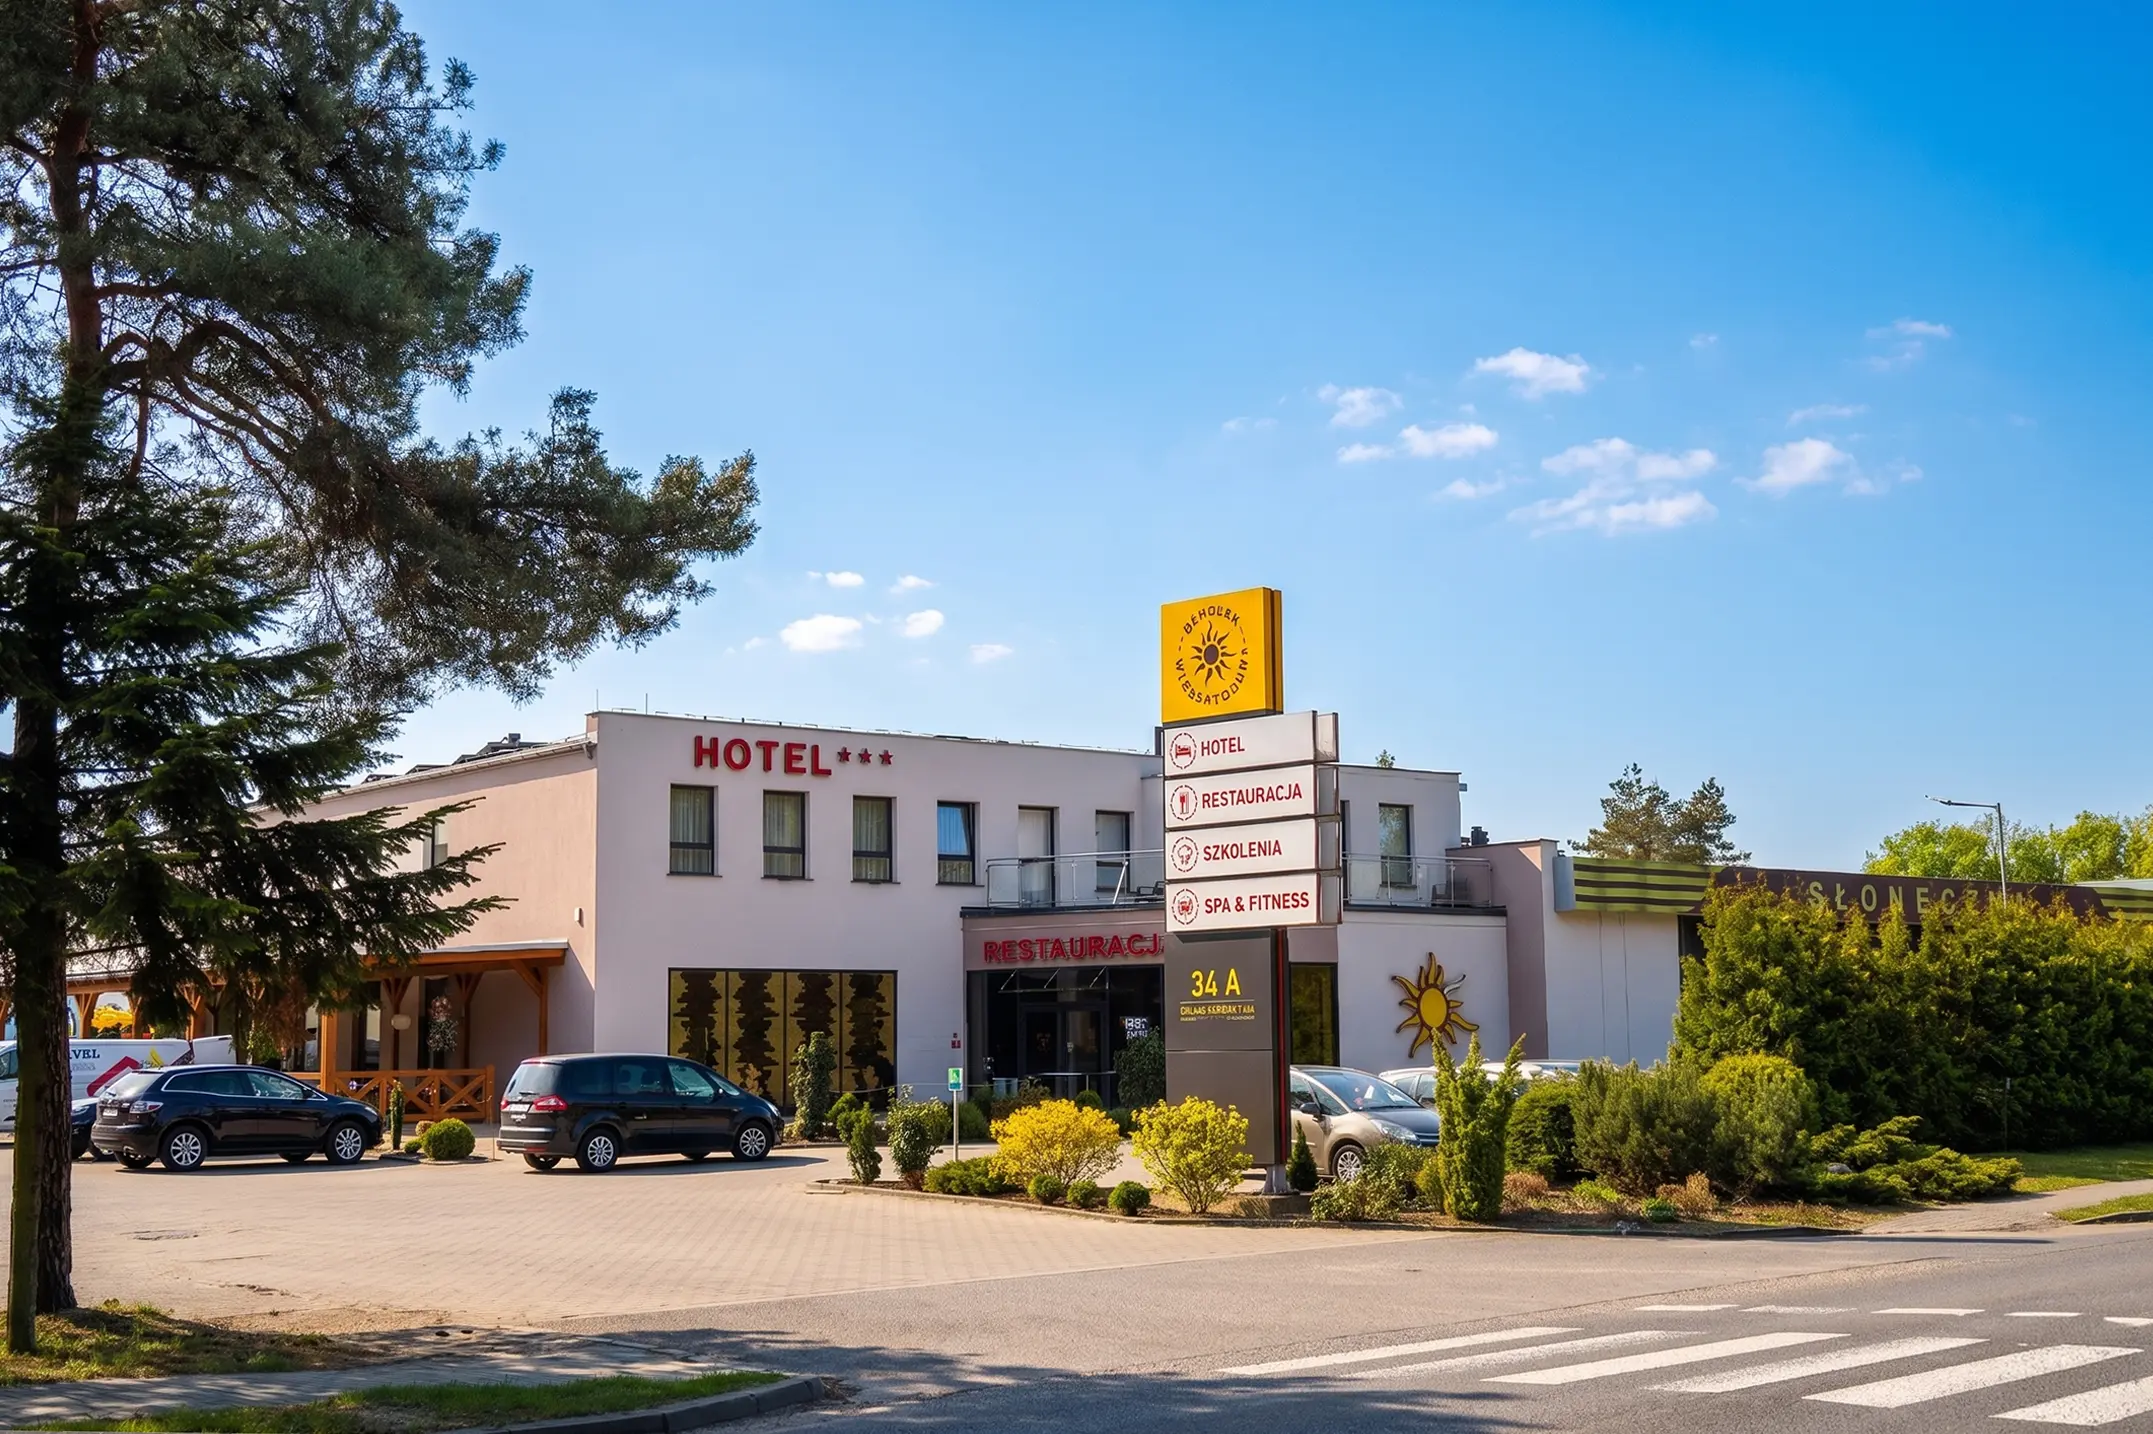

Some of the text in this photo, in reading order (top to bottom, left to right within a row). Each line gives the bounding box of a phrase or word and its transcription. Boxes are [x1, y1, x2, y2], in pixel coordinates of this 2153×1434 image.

[694, 736, 832, 776] HOTEL
[1201, 737, 1245, 756] HOTEL
[1202, 783, 1302, 809] RESTAURACJA
[1203, 840, 1282, 861] SZKOLENIA
[1205, 892, 1309, 914] SPA & FITNESS
[984, 933, 1164, 963] RESTAURACJ
[1191, 968, 1241, 997] 34 A
[70, 1049, 100, 1060] VEL
